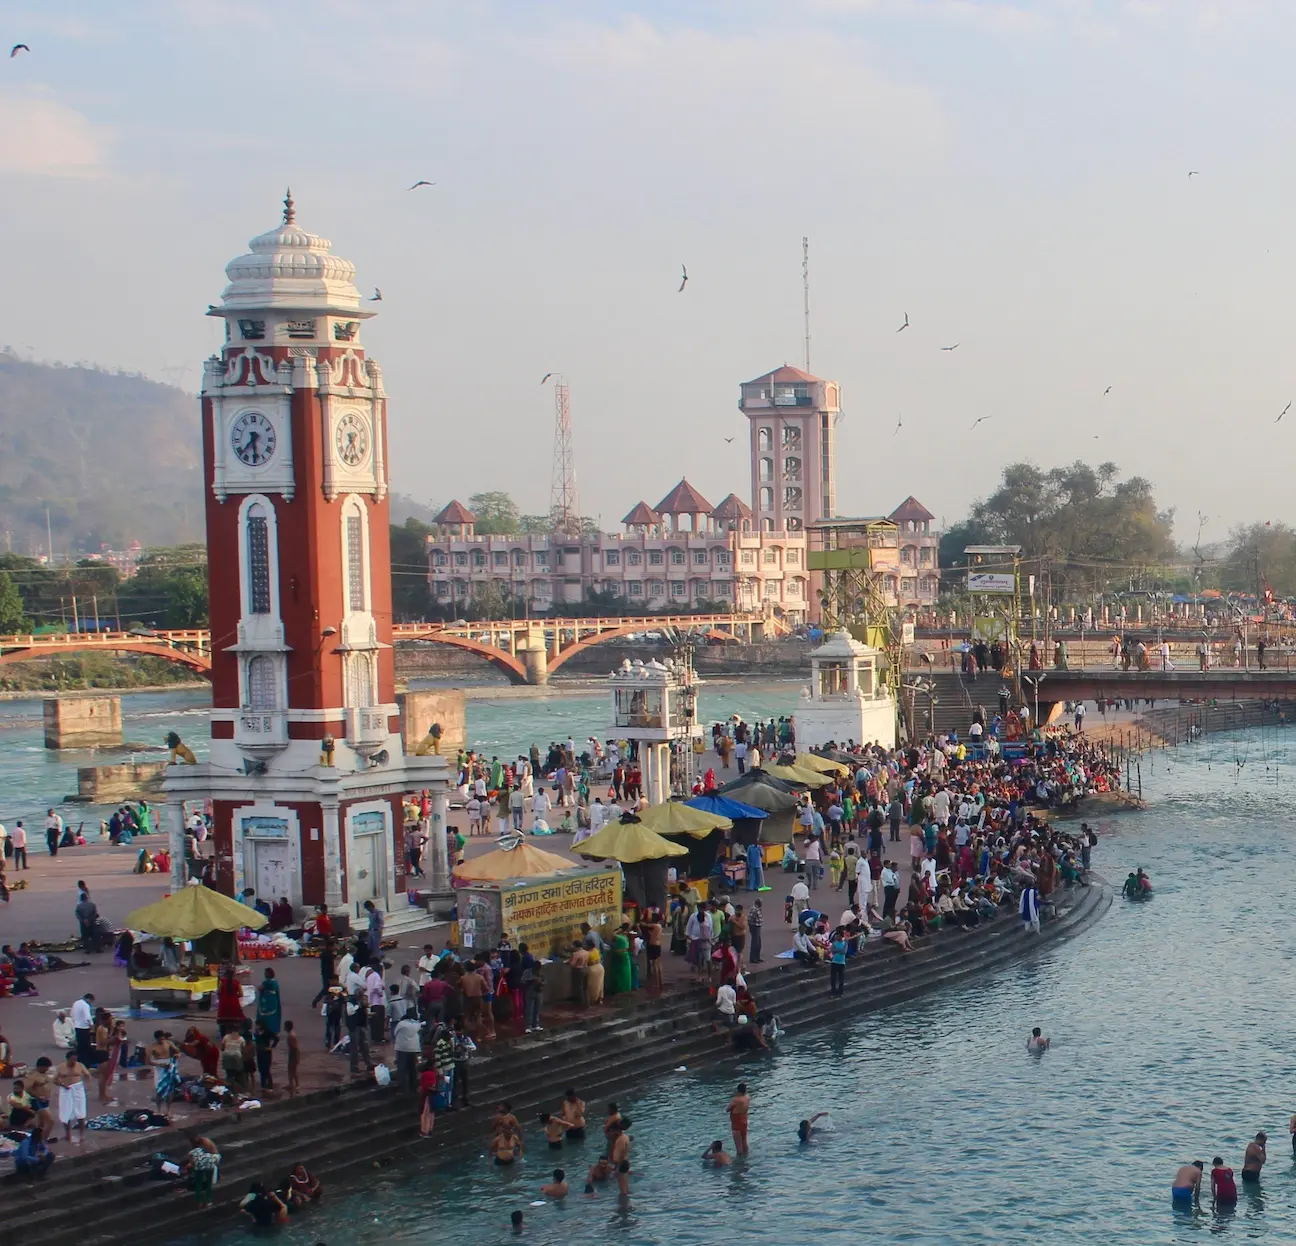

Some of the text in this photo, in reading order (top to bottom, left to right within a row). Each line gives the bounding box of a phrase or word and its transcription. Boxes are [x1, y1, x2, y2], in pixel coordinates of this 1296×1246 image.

[505, 892, 517, 908] श्री
[518, 891, 539, 905] गंगा
[541, 886, 561, 900] सभा
[535, 901, 559, 917] हार्दिक
[559, 897, 585, 912] स्वागत
[586, 891, 606, 906] करती
